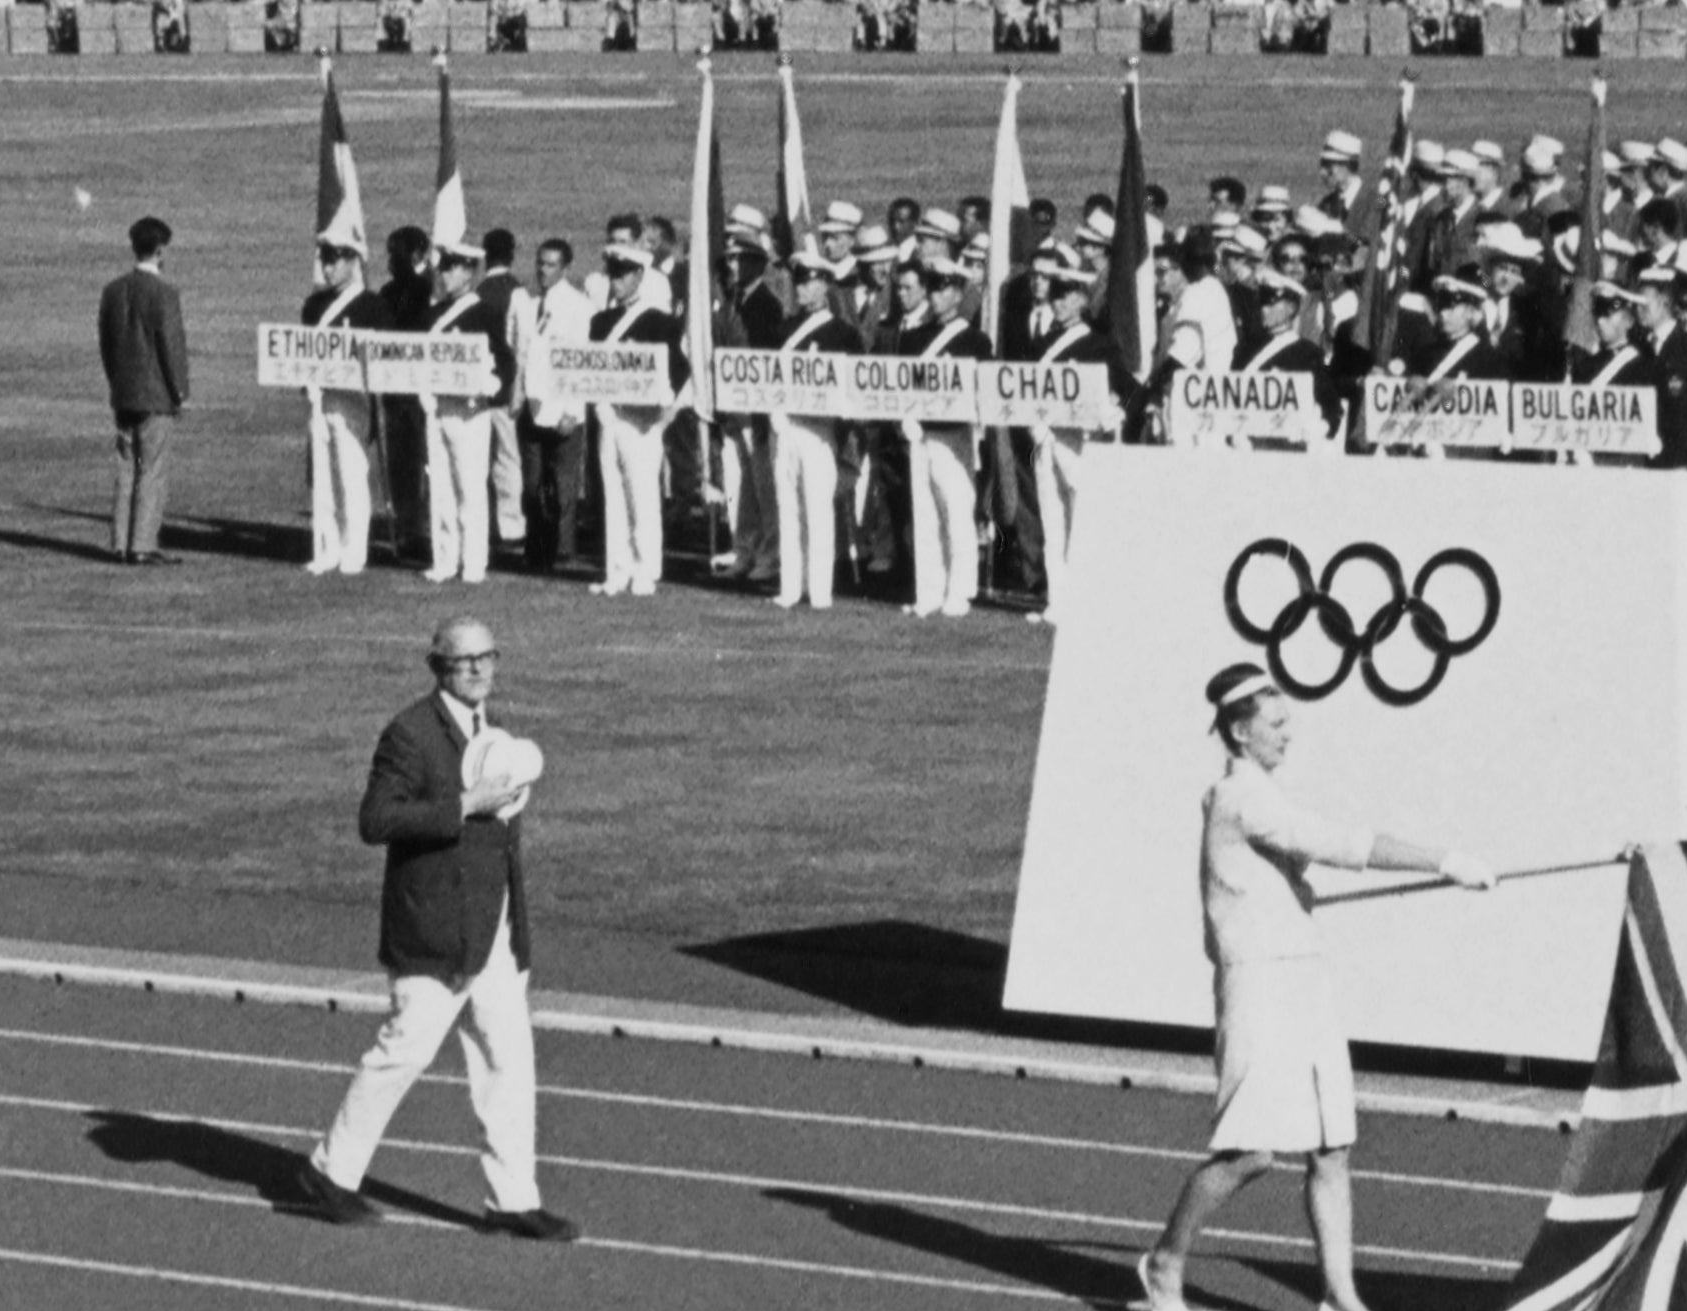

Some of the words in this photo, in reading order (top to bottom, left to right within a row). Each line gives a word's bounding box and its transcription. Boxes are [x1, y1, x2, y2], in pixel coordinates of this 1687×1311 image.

[268, 329, 359, 362] ETHIOPIA
[429, 341, 482, 364] REPUBLIC
[550, 348, 657, 373] CZECHOSLOVAKIA
[720, 354, 784, 384] COSTA
[791, 357, 838, 387] RICA
[855, 360, 964, 392] COLOMBIA
[997, 366, 1081, 402] CHAD
[1184, 373, 1300, 411] CANADA
[1373, 382, 1498, 415] CAODIA
[1522, 388, 1643, 422] BULGARIA
